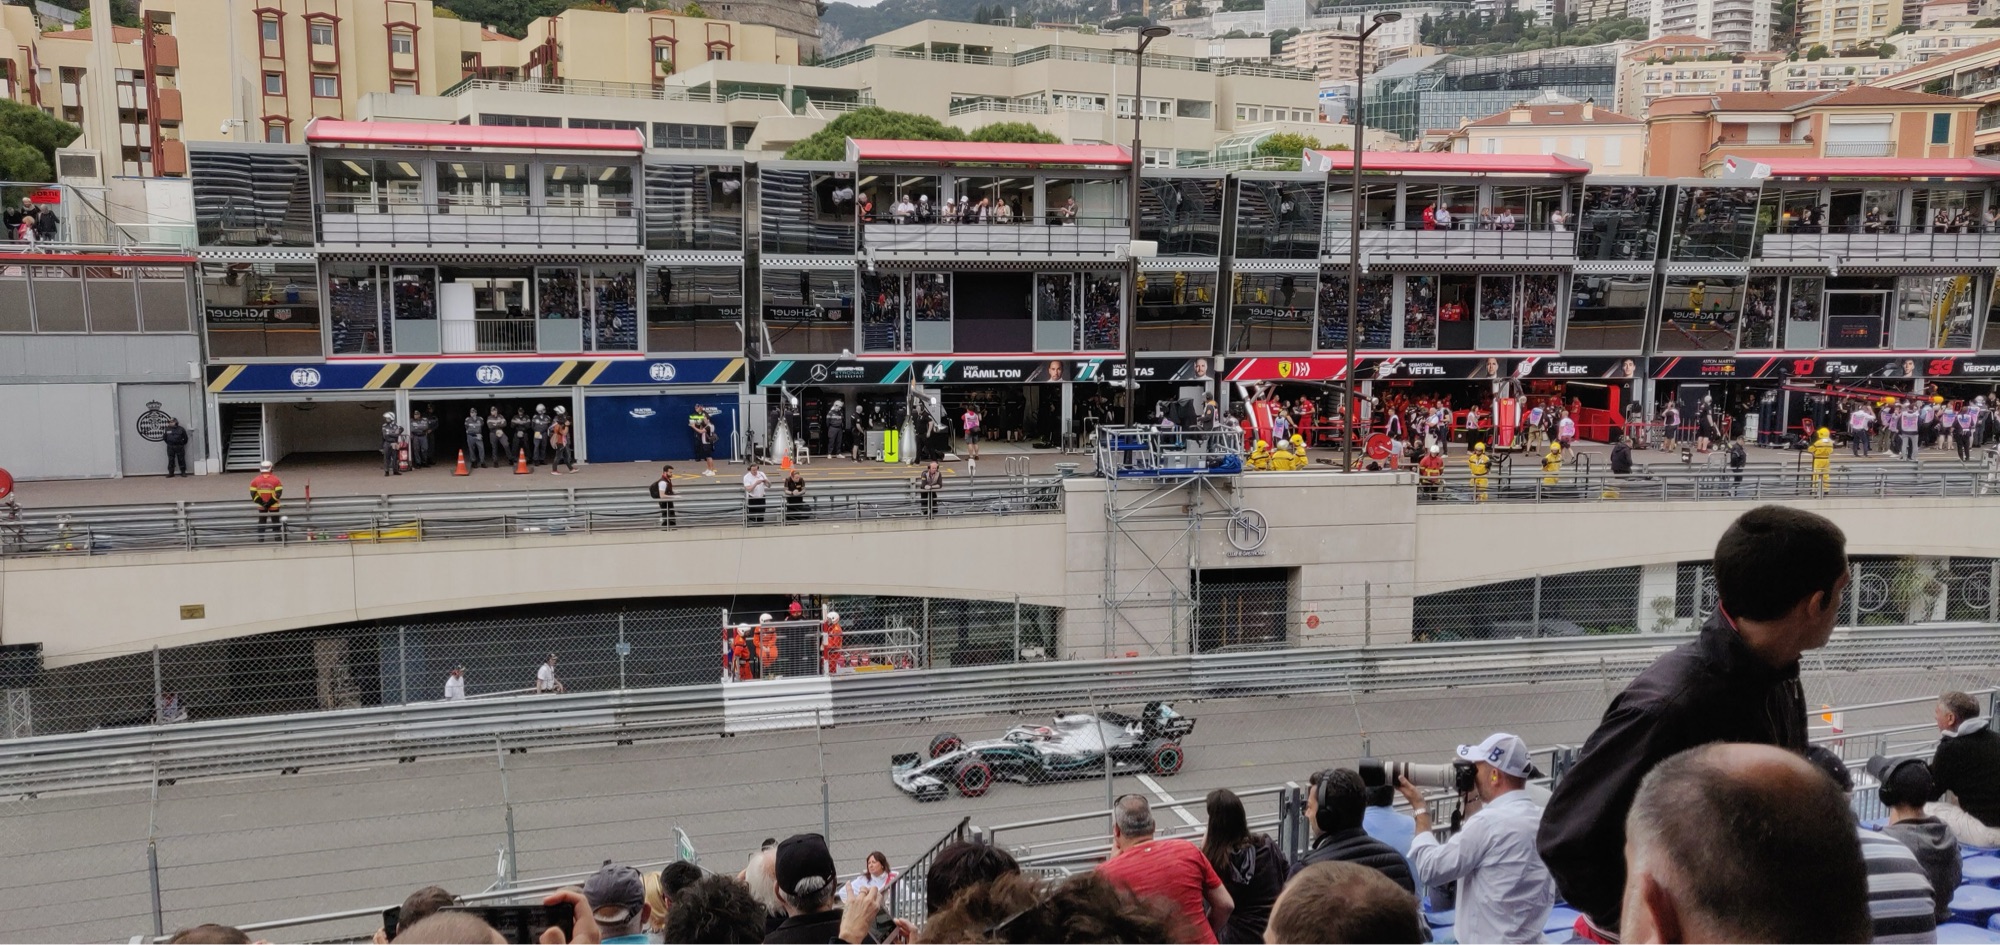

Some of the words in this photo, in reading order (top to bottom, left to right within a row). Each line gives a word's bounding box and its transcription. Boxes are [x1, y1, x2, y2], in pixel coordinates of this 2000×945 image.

[922, 364, 945, 379] 44
[1077, 362, 1100, 378] 77
[1112, 368, 1154, 376] BOTAS
[1408, 366, 1446, 374] VETTEL
[1547, 365, 1588, 374] LECLERC
[1793, 360, 1815, 374] 10
[1928, 360, 1954, 374] 33
[963, 370, 1021, 378] HAMILTON
[1124, 722, 1144, 735] 44
